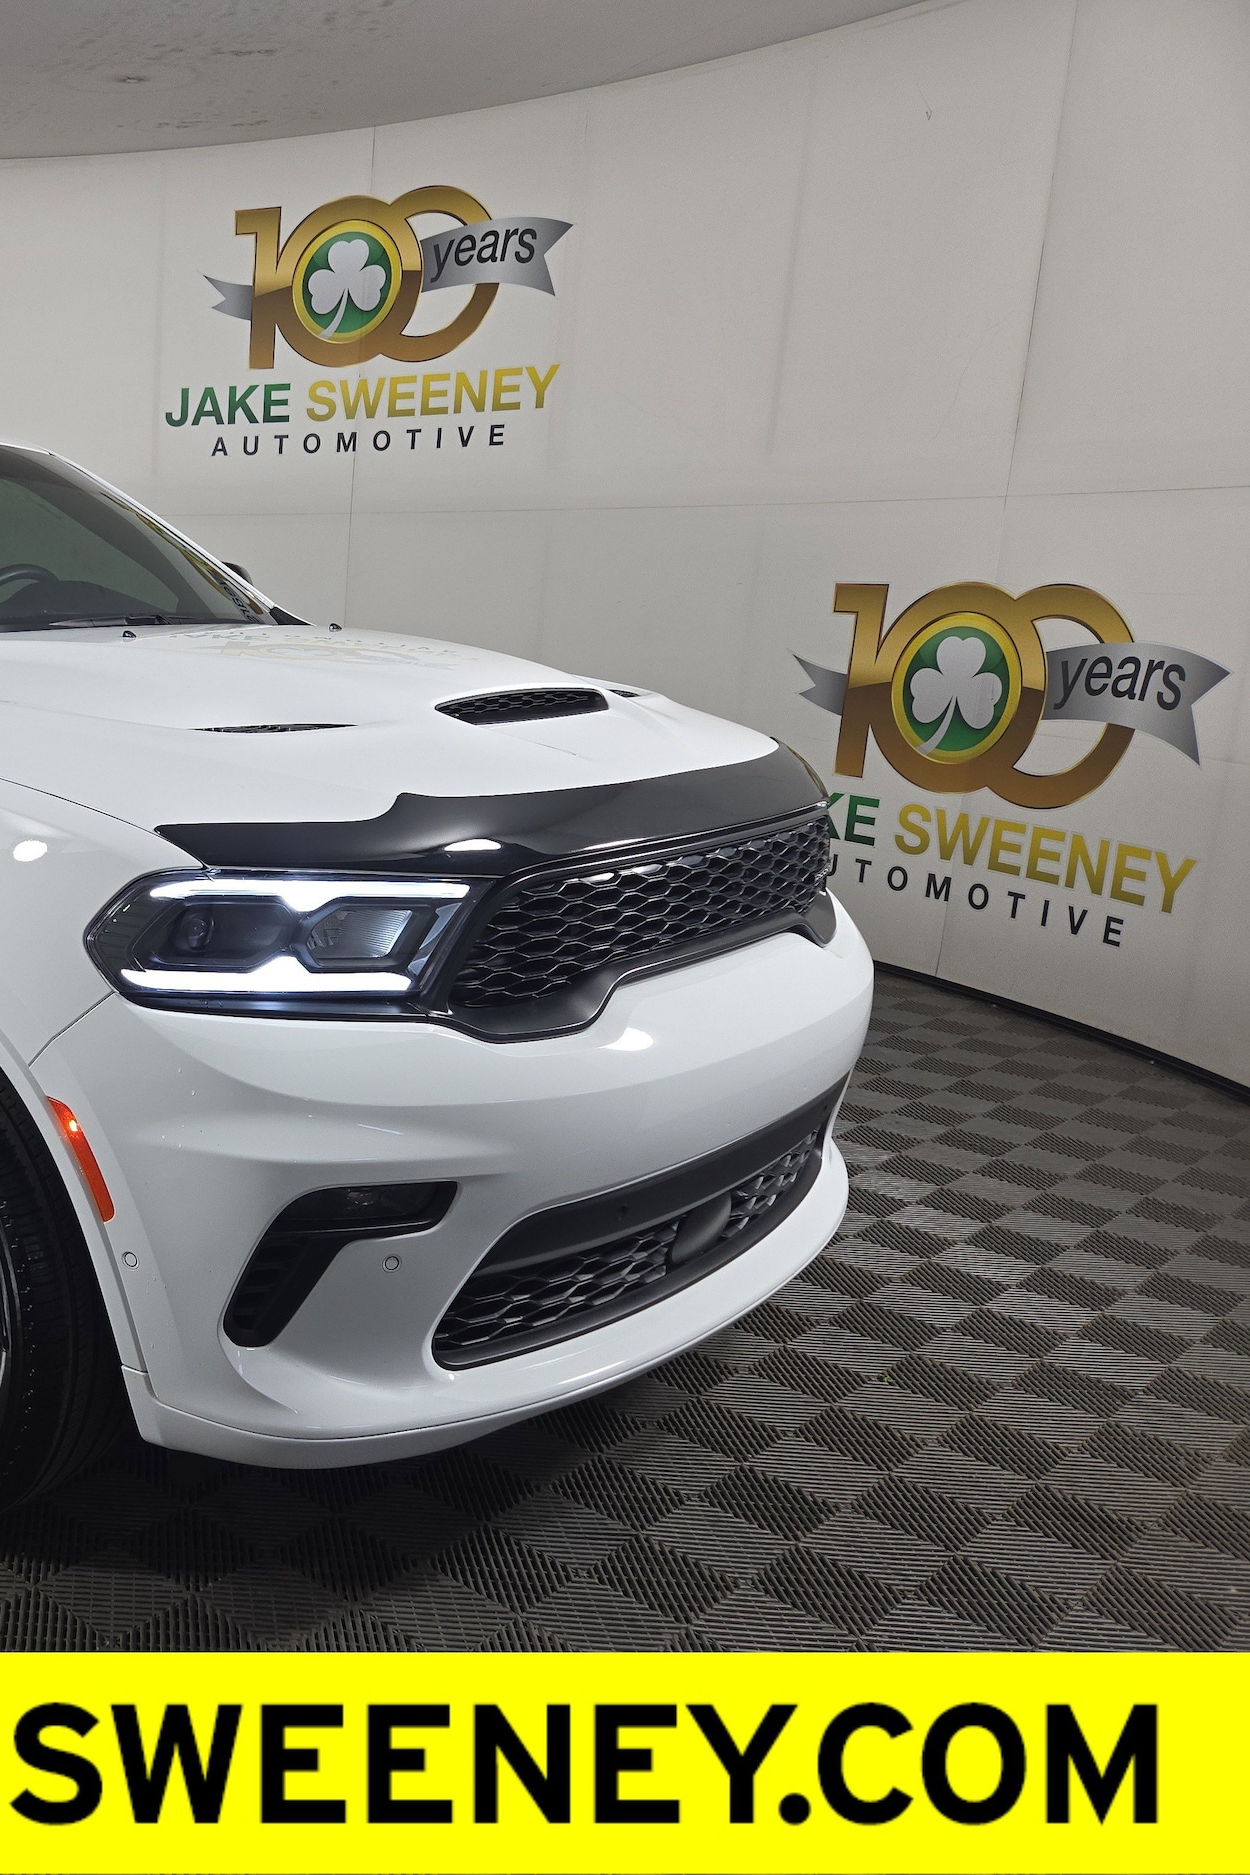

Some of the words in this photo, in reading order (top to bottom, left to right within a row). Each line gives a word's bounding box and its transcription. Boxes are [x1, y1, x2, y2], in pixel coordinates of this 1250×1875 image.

[430, 227, 538, 284] years
[165, 382, 292, 428] JAKE
[306, 364, 561, 422] SWEENEY
[211, 423, 506, 458] AUTOMOTIVE
[1053, 653, 1186, 712] years
[894, 803, 1197, 915] SWEENEY
